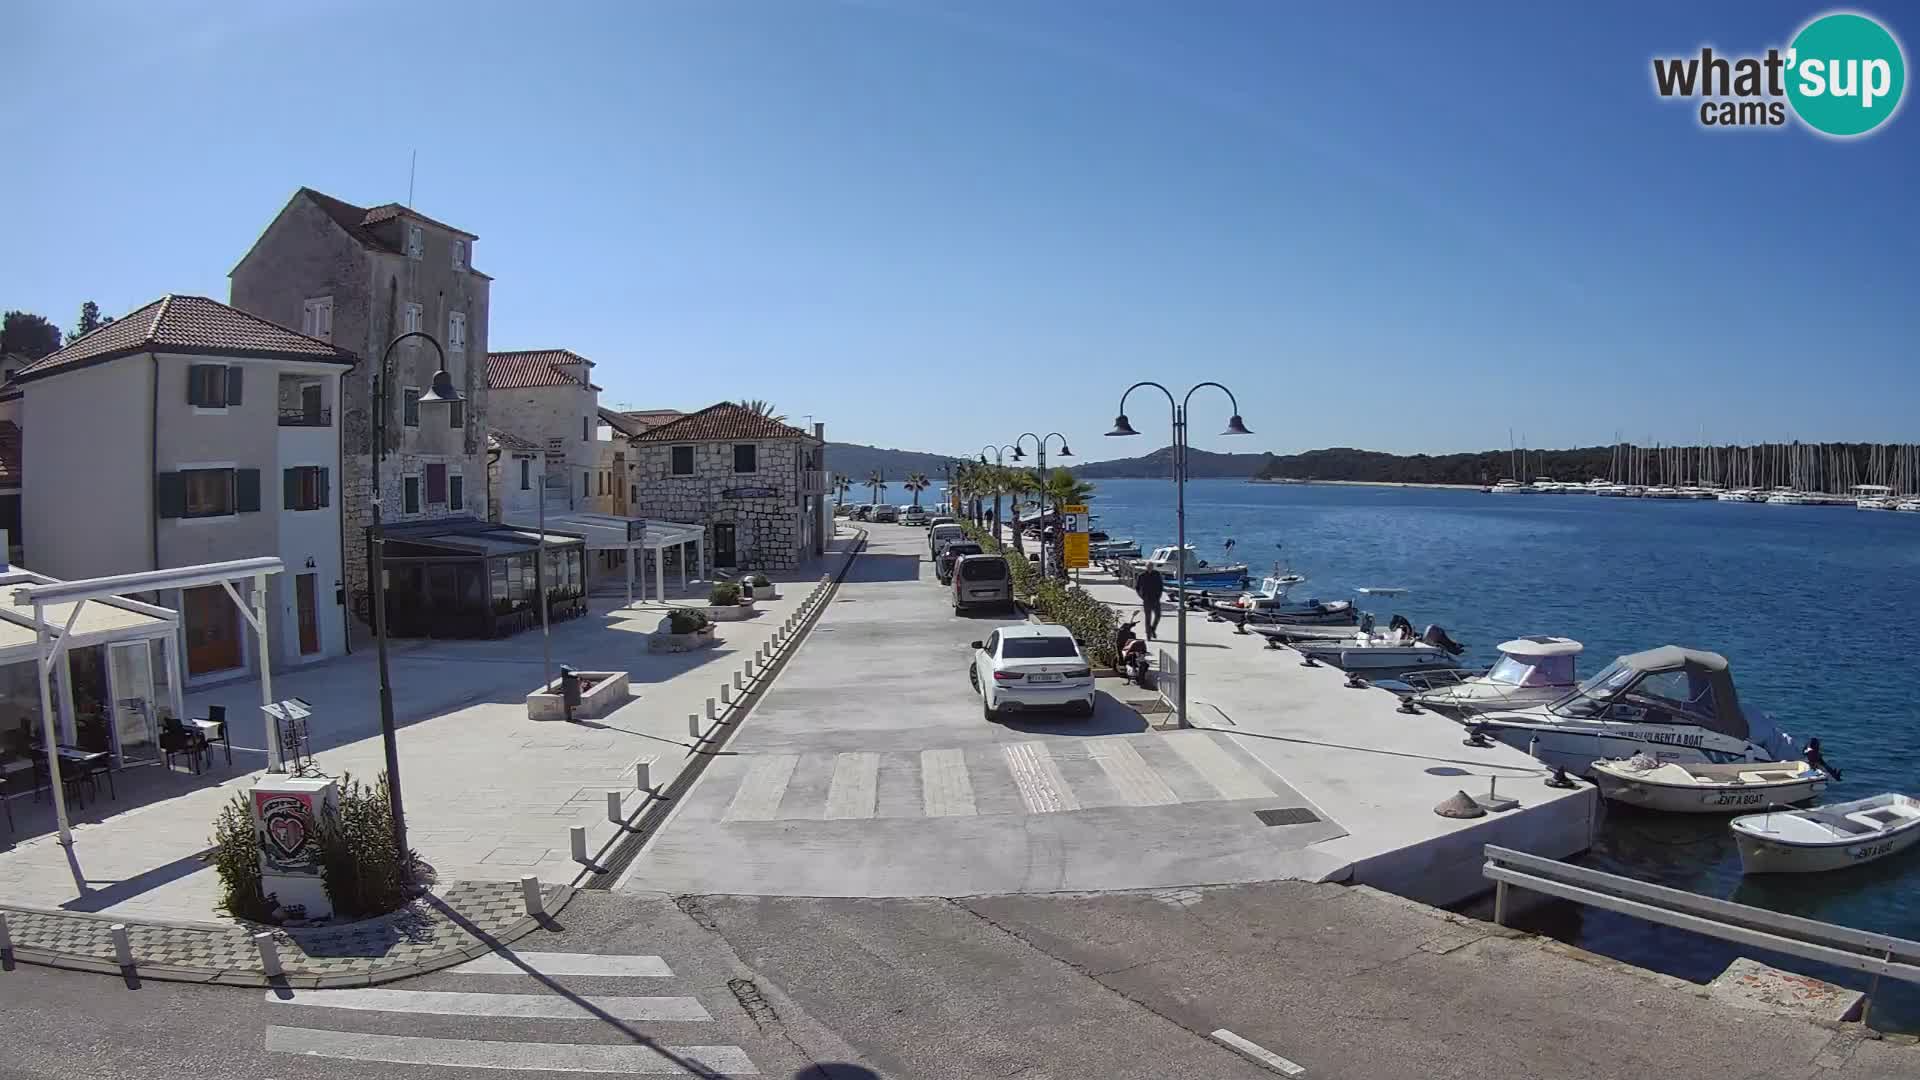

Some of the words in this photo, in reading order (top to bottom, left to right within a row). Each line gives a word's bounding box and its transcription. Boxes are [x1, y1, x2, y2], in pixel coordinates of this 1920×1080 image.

[1065, 515, 1076, 531] P
[1654, 732, 1676, 744] RENT
[1684, 734, 1704, 747] BOAT
[1736, 795, 1743, 805] A
[1743, 794, 1764, 805] BOAT
